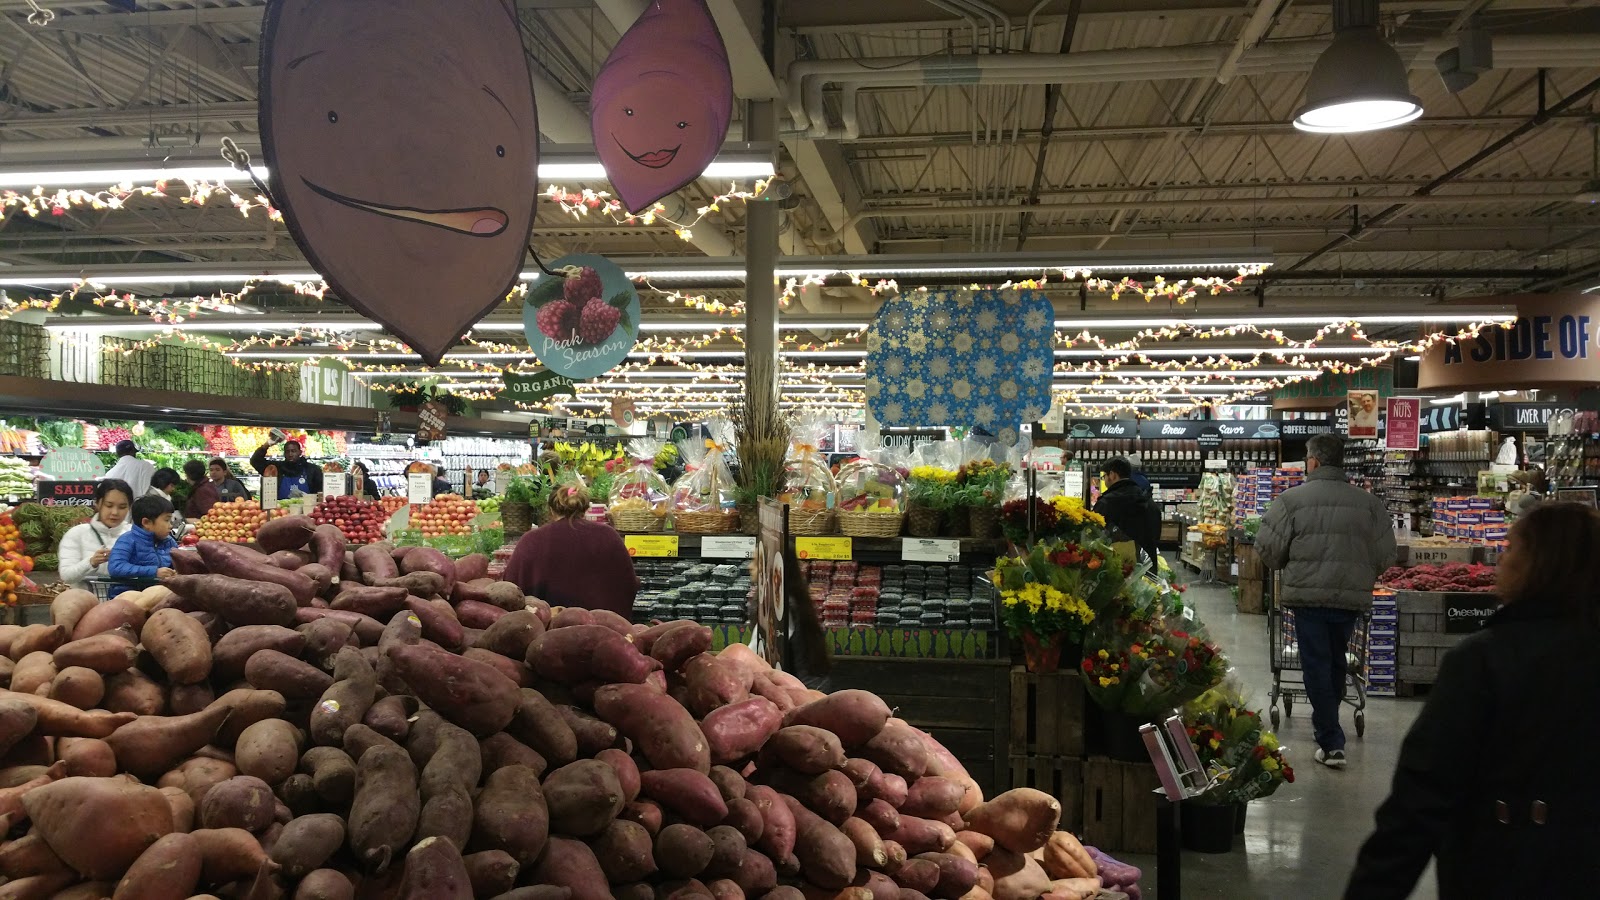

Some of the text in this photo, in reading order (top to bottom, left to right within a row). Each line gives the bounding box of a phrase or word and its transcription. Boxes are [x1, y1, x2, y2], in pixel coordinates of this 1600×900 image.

[542, 327, 584, 357] Peak
[1444, 314, 1592, 366] A SIDE OF
[562, 340, 627, 370] Season
[300, 365, 321, 404] SET
[323, 367, 339, 396] US
[513, 376, 574, 393] ORGANIC
[1392, 404, 1412, 418] NUTS
[1516, 408, 1540, 424] LAYER
[1100, 424, 1125, 434] Wake
[1161, 423, 1187, 434] Brew
[1218, 424, 1245, 434] Savor
[1282, 425, 1307, 435] COFFEE
[52, 460, 93, 473] HOLIDAYS
[54, 484, 94, 495] SALE
[40, 496, 69, 507] Geen
